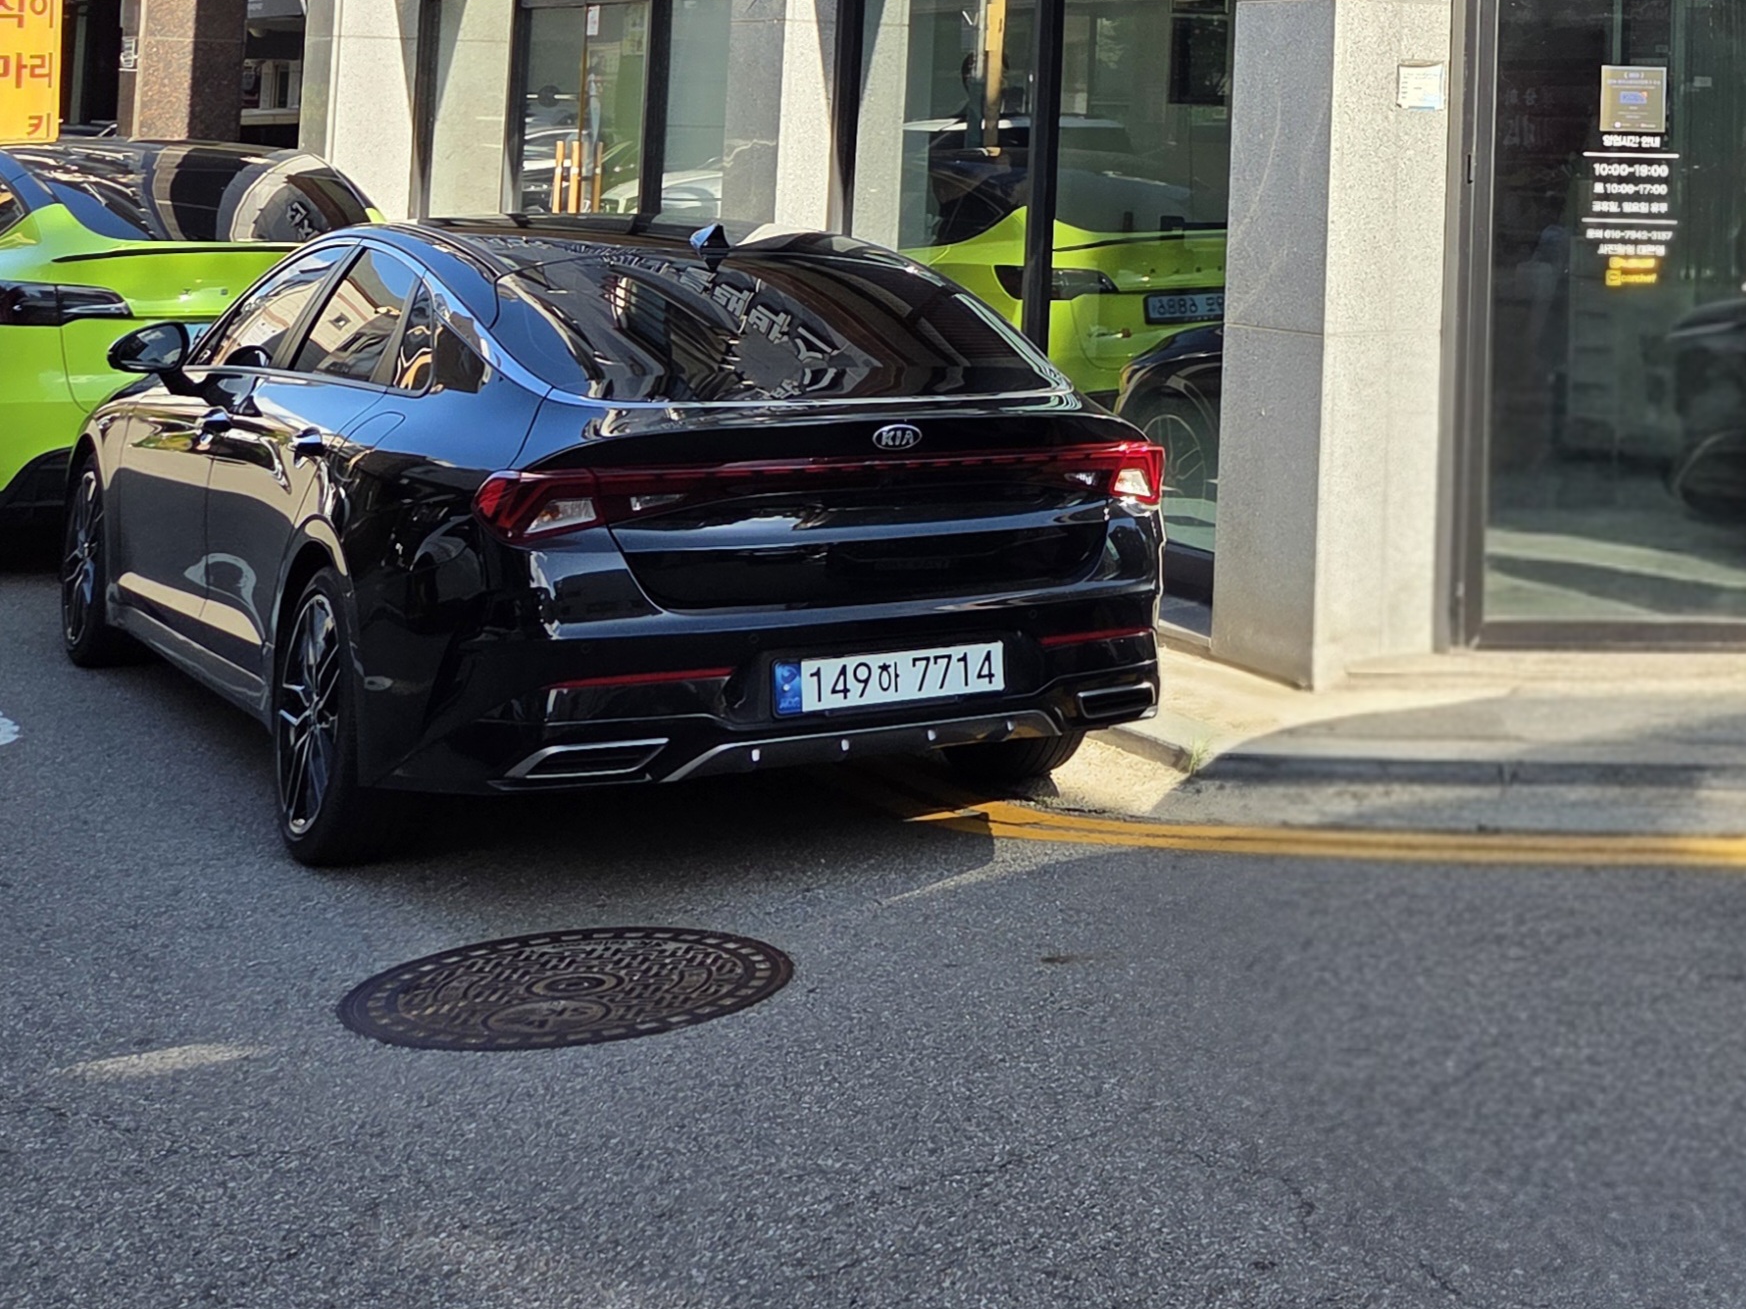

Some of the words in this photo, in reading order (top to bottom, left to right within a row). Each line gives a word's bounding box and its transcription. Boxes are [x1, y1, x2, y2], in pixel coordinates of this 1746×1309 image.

[880, 430, 917, 447] KIA
[809, 661, 900, 703] 149하
[911, 650, 996, 693] 7714
